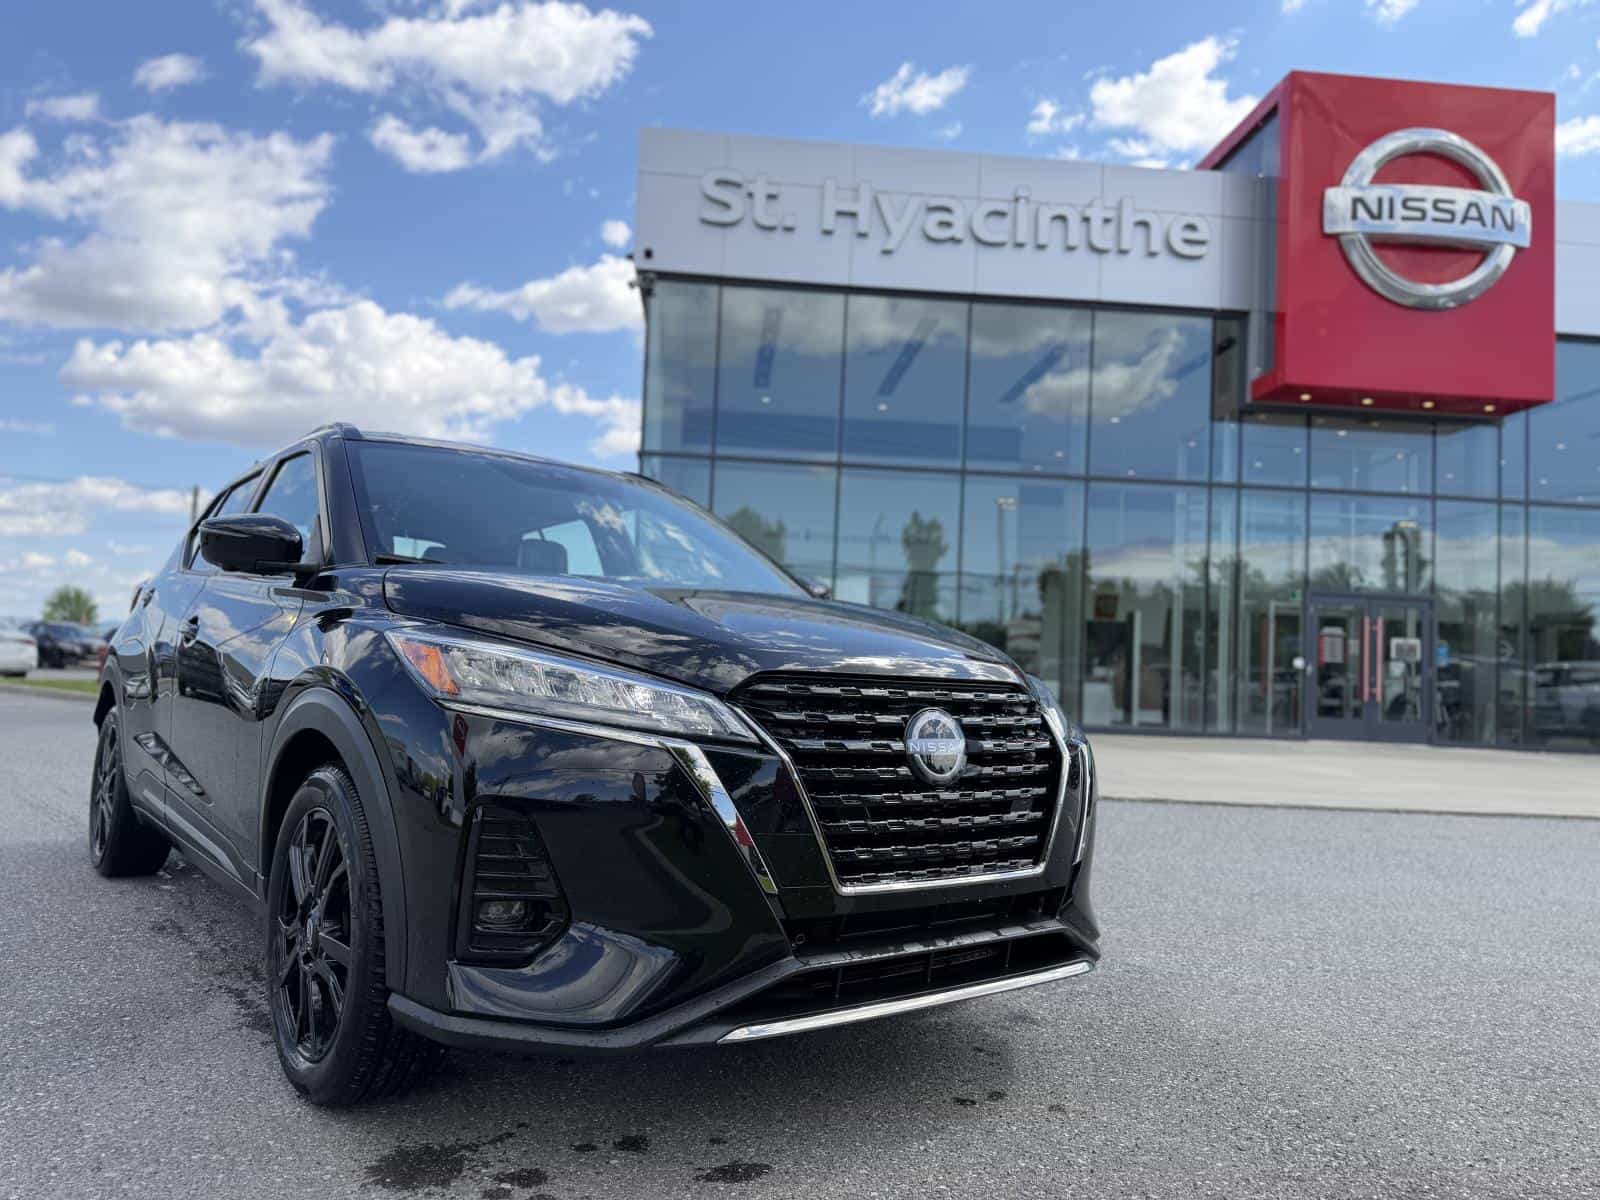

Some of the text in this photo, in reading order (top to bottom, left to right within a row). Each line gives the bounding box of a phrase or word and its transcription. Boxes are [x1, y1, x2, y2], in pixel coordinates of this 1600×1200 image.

[700, 168, 1211, 260] St. Hyacinthe
[1351, 196, 1515, 232] NISSAN
[909, 741, 962, 753] NISSA
